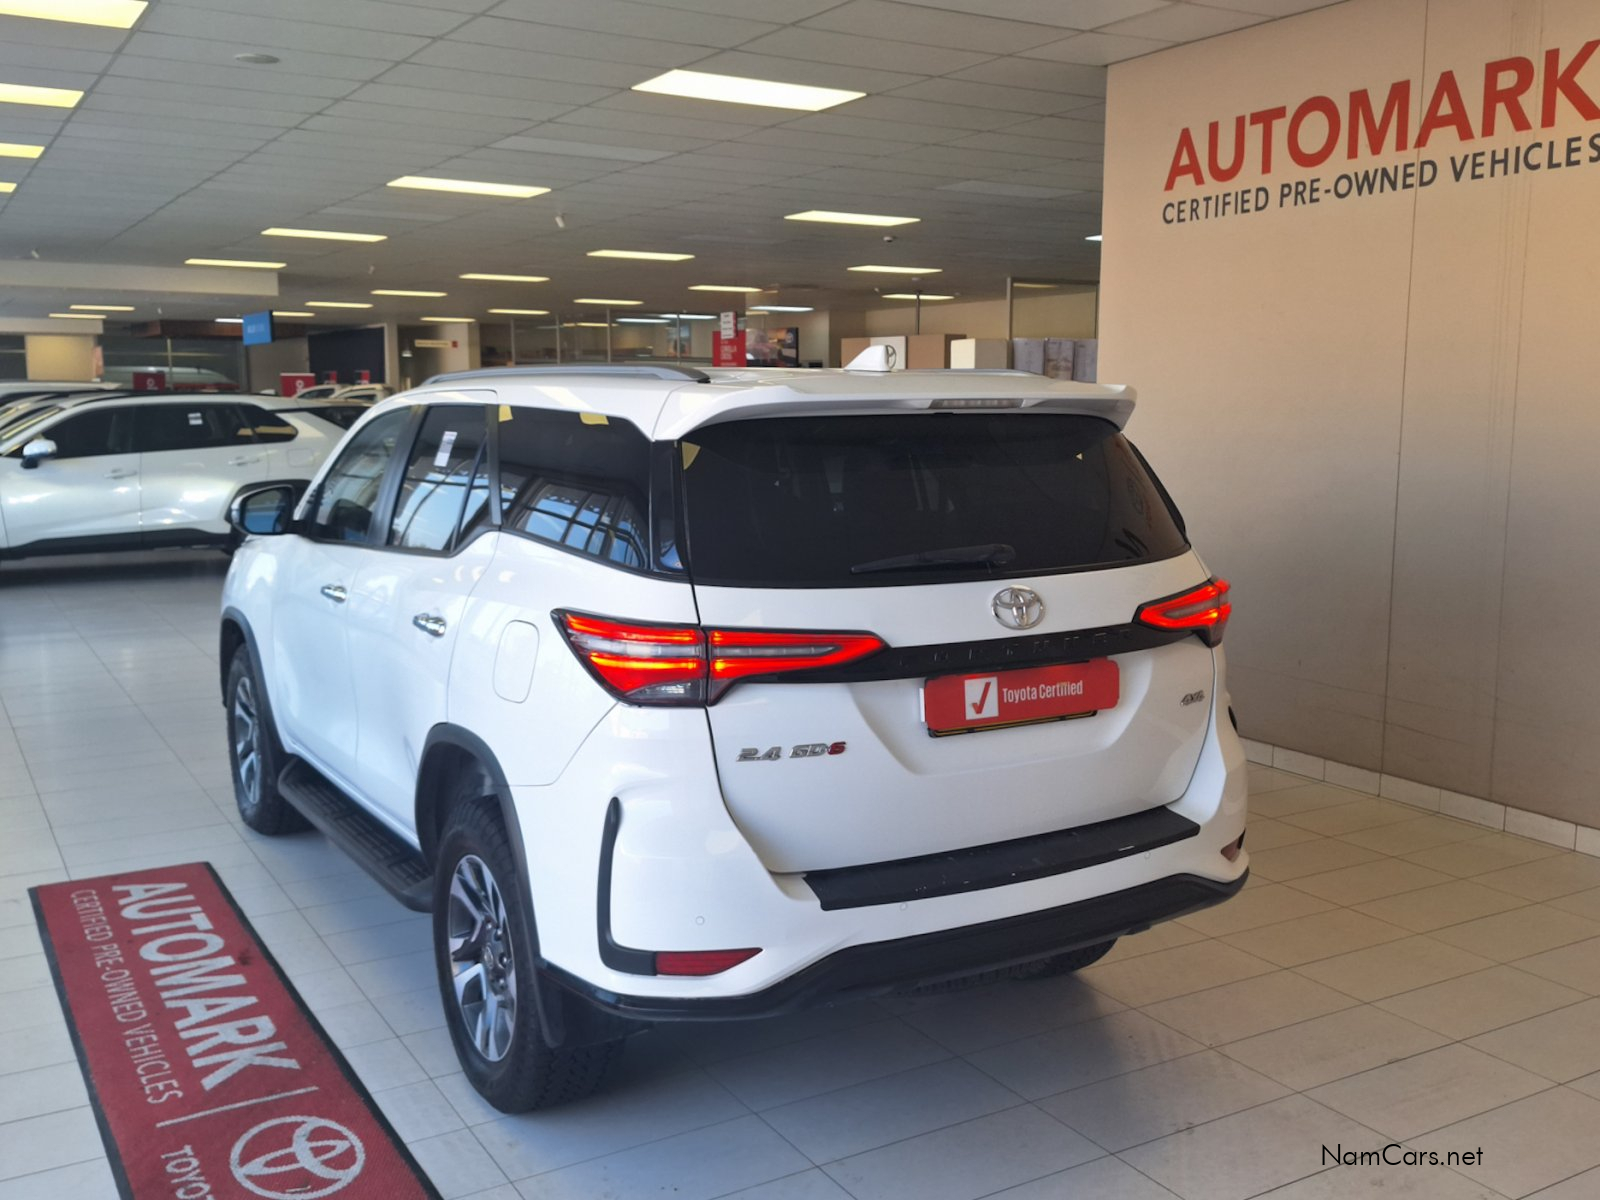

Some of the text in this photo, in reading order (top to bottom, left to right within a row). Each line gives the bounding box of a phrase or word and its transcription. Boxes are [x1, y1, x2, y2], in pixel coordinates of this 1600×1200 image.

[1165, 40, 1600, 192] AUTOMARK
[1162, 132, 1600, 225] CERTIFIED PRE-OWNED VEHICLES
[1002, 680, 1083, 704] Toyota Certified
[736, 745, 783, 762] 2.4
[70, 888, 184, 1105] CERTIFIED PRE-OWNED VEHICLES
[111, 882, 300, 1092] AUTOMARK
